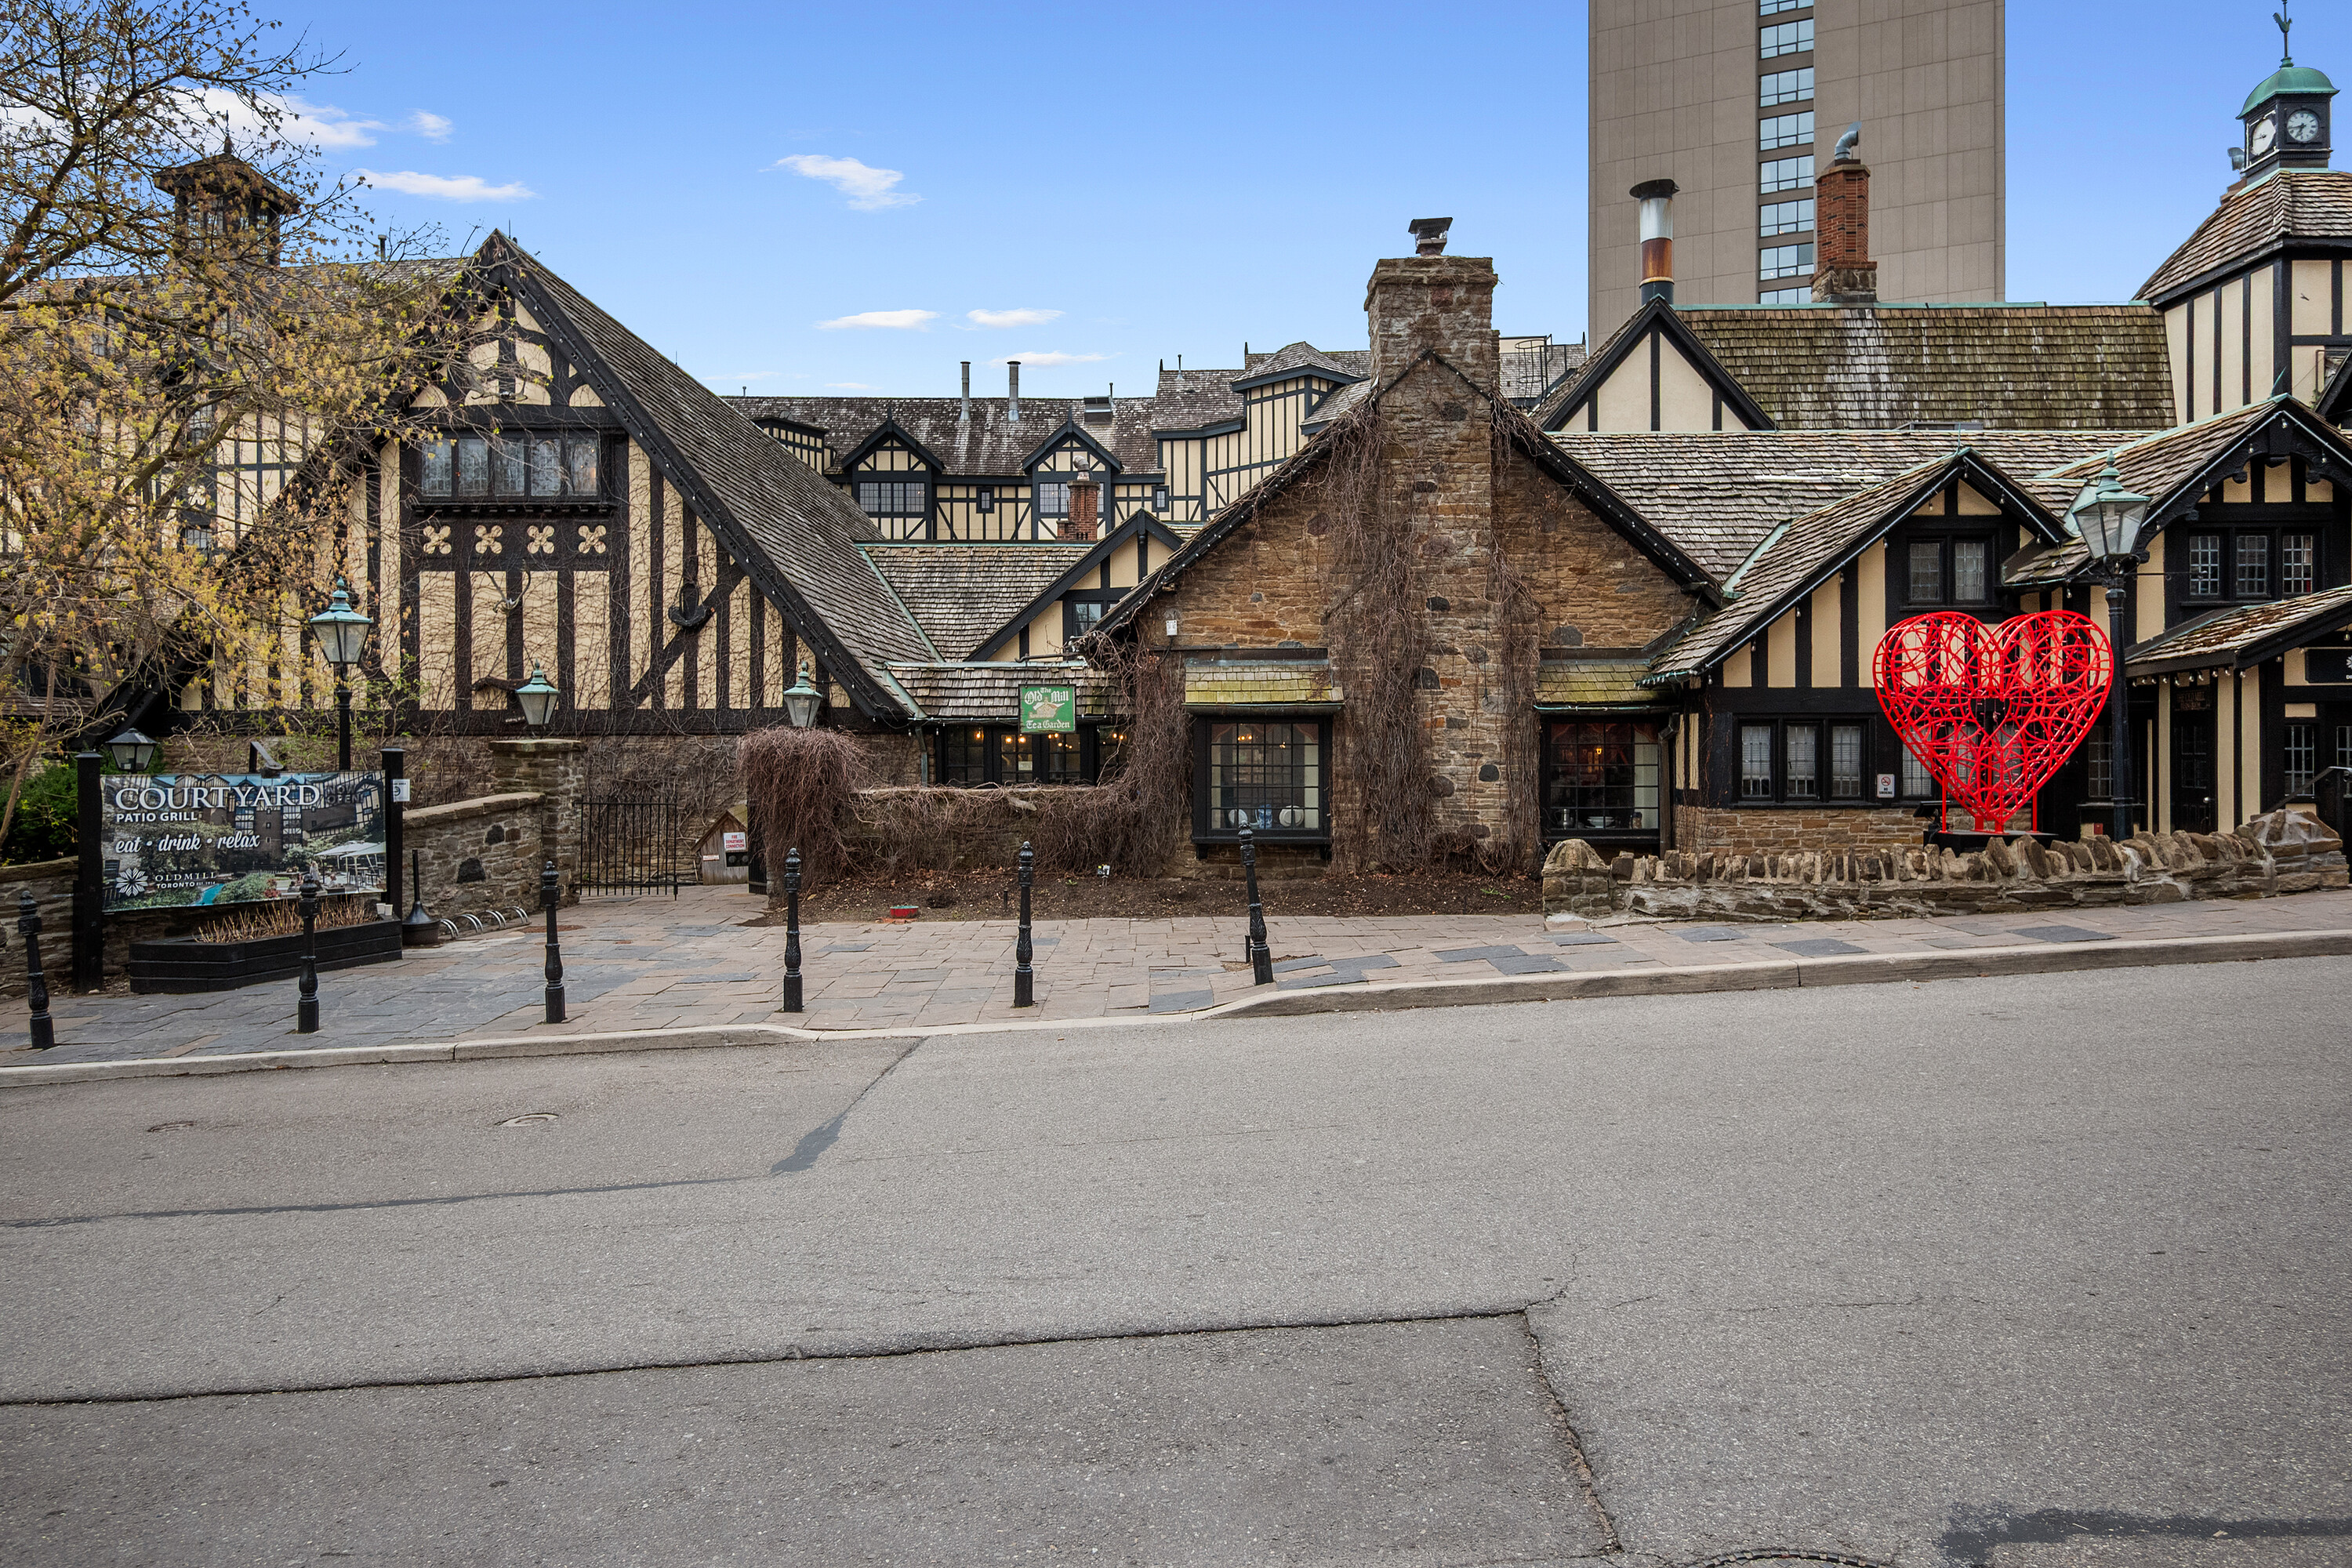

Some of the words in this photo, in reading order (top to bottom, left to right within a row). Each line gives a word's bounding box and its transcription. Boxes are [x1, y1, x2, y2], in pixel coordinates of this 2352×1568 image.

[1025, 691, 1043, 705] Old
[1051, 691, 1069, 703] Mill
[1025, 720, 1042, 729] Tea
[1043, 719, 1070, 728] Garden
[326, 784, 357, 795] NOW
[115, 785, 320, 811] COURTYARD
[117, 812, 156, 822] PATIO
[160, 811, 198, 822] GRILL
[115, 836, 142, 854] eat
[158, 833, 202, 852] drink
[217, 830, 261, 850] relax
